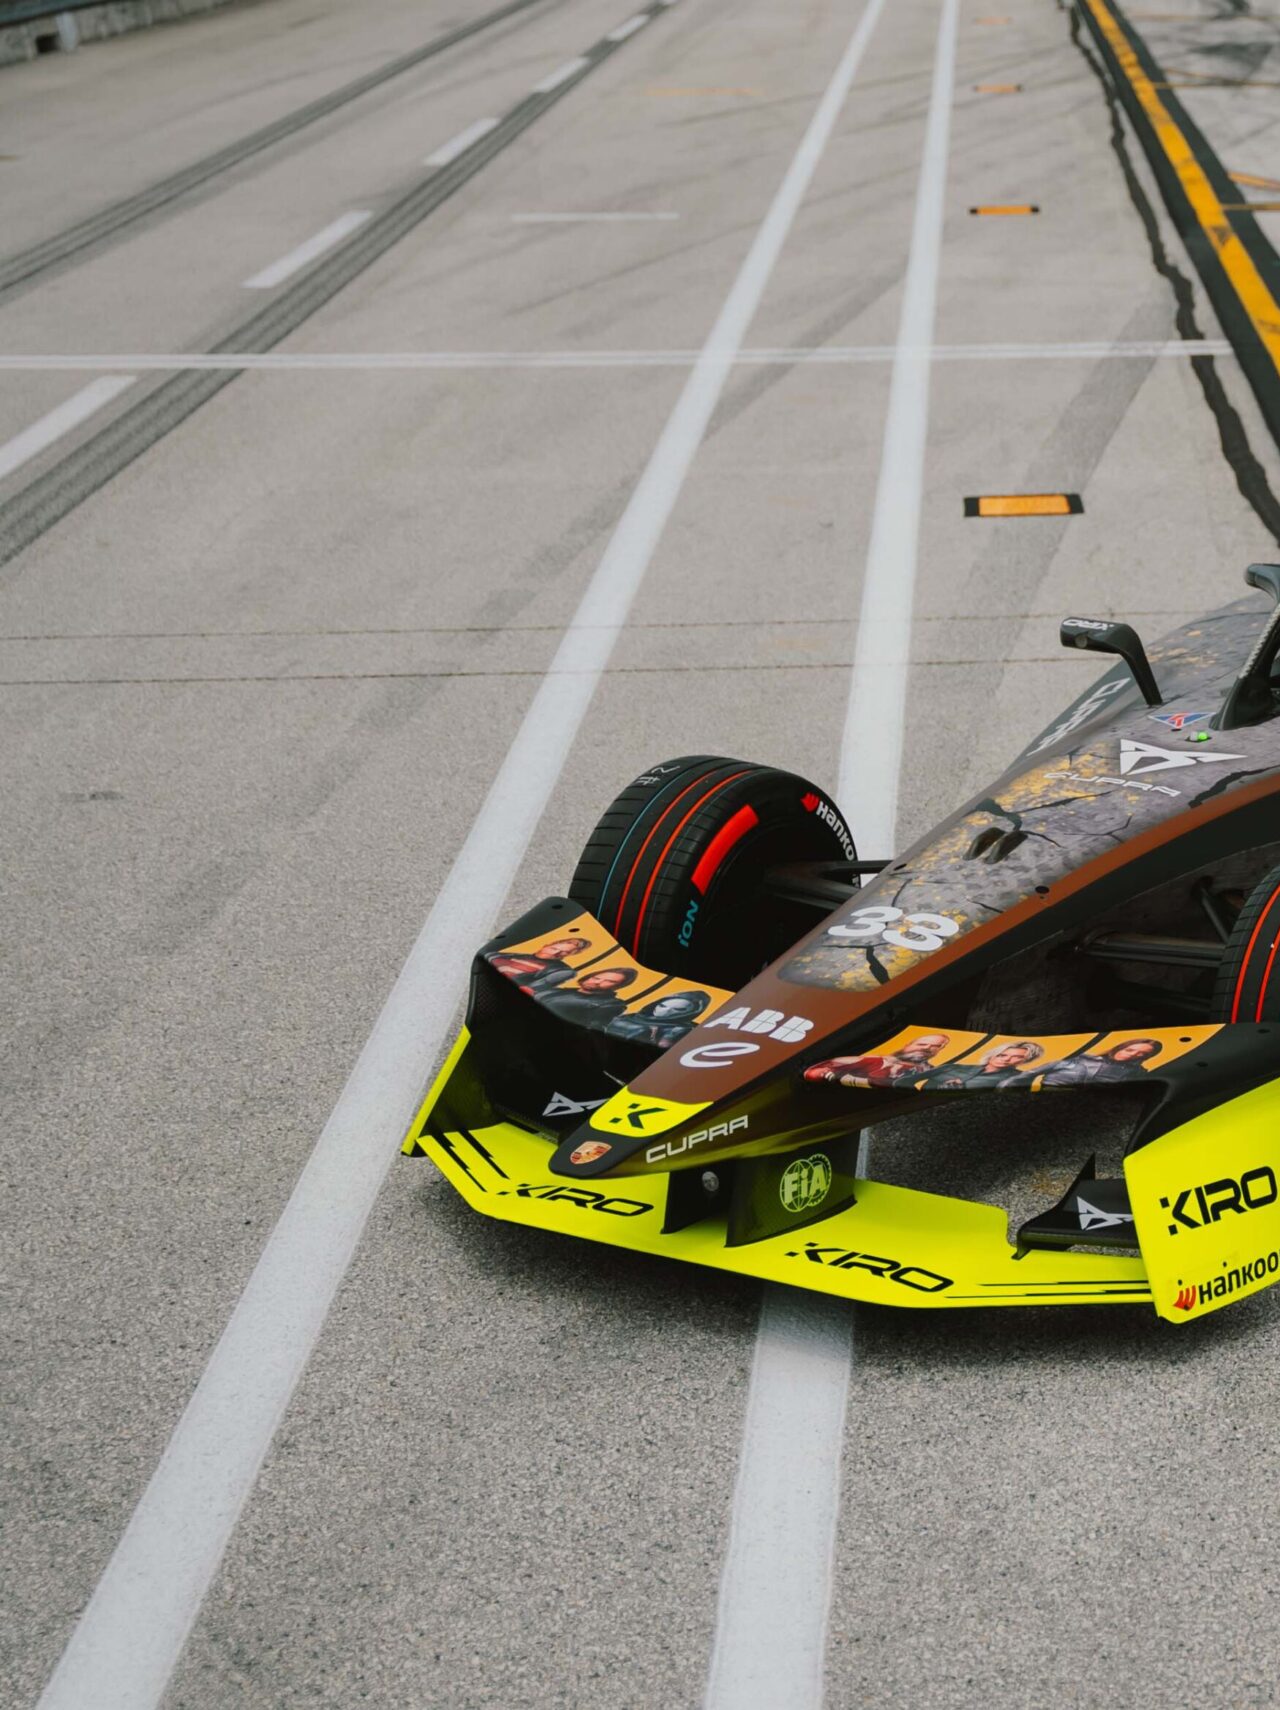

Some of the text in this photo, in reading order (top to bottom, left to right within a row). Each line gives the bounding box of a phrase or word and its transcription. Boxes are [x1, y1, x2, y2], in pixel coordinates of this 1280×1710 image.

[1043, 771, 1182, 798] CUPRA
[827, 906, 960, 951] 33
[703, 1006, 815, 1043] ABB
[646, 1114, 749, 1164] CUPRA
[496, 1183, 654, 1217] KIRO
[1160, 1165, 1278, 1236] KIRO
[783, 1241, 955, 1293] KIRO
